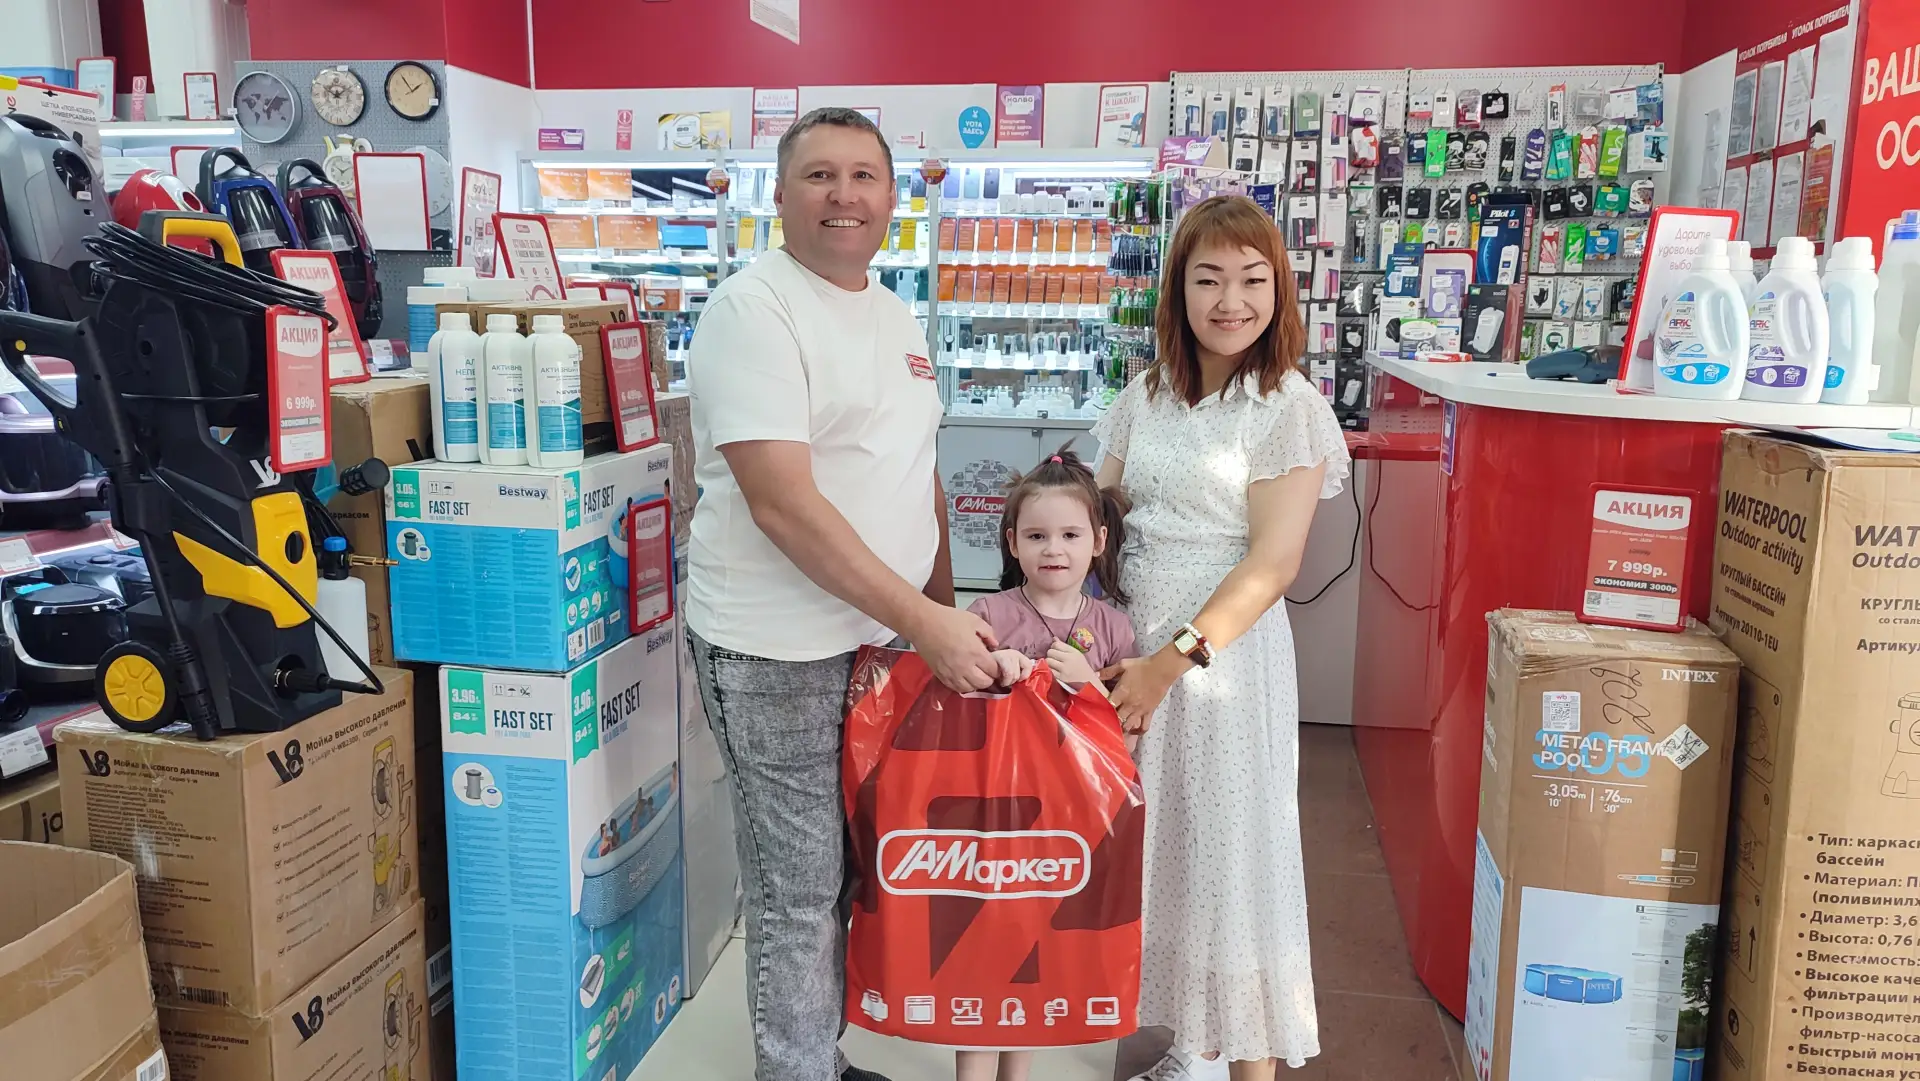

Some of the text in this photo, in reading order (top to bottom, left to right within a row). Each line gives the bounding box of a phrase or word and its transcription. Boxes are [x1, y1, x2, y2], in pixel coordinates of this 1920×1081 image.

[1792, 21, 1814, 39] УГОЛОК
[962, 127, 985, 135] ЗДЕСЬ
[965, 120, 983, 128] YOTA
[1489, 209, 1516, 218] Pilot S
[1675, 226, 1711, 242] Дарите
[289, 265, 330, 283] АКЦИЯ
[281, 326, 319, 346] АКЦИЯ
[612, 335, 639, 351] АКЦИЯ
[286, 395, 317, 410] 6 999р.
[647, 458, 669, 473] Bestway
[499, 485, 547, 499] Bestway
[584, 484, 615, 515] FAST SET
[429, 500, 471, 516] FAST SET
[1607, 500, 1684, 520] АКЦИЯ
[1725, 489, 1808, 544] WATERPOOL
[1855, 524, 1920, 547] WAT
[1721, 520, 1804, 576] Outdoor activity
[1607, 560, 1668, 578] 7 999р.
[1852, 552, 1920, 569] Outdo
[1594, 577, 1678, 594] ЭКОНОМИЯ 3000р
[1720, 561, 1786, 607] КРУГЛЫЙ БАССЕЙН
[1715, 604, 1779, 652] Артикул 20110-1EU
[646, 630, 673, 656] Bestway
[1661, 668, 1719, 684] INTEX
[452, 688, 475, 704] 3.96
[601, 680, 642, 732] FAST SET
[453, 712, 470, 720] 84
[494, 709, 553, 731] FAST SET
[306, 698, 407, 753] Мойка высокого давления
[1542, 733, 1603, 752] METAL
[79, 749, 110, 777] V8
[114, 759, 140, 769] Мойка
[180, 767, 220, 778] давления
[266, 739, 304, 783] V8
[1818, 833, 1854, 847] Тип:
[1816, 853, 1885, 867] бассейн
[1814, 872, 1902, 888] Материал:
[1810, 911, 1918, 928] Диаметр: 3,6
[1808, 930, 1913, 949] Высота: 0,76
[326, 928, 417, 1005] Мойка высокого давления
[1807, 950, 1920, 967] Вместимость:
[1805, 969, 1920, 986] Высокое каче
[1587, 982, 1612, 992] INTEX
[1803, 987, 1908, 1005] фильтрации
[292, 995, 324, 1041] V8
[211, 1035, 249, 1045] давления
[1799, 1026, 1920, 1044] фильтр-насоса
[1798, 1044, 1877, 1062] Быстрый
[1796, 1062, 1920, 1081] Безопасная уст
